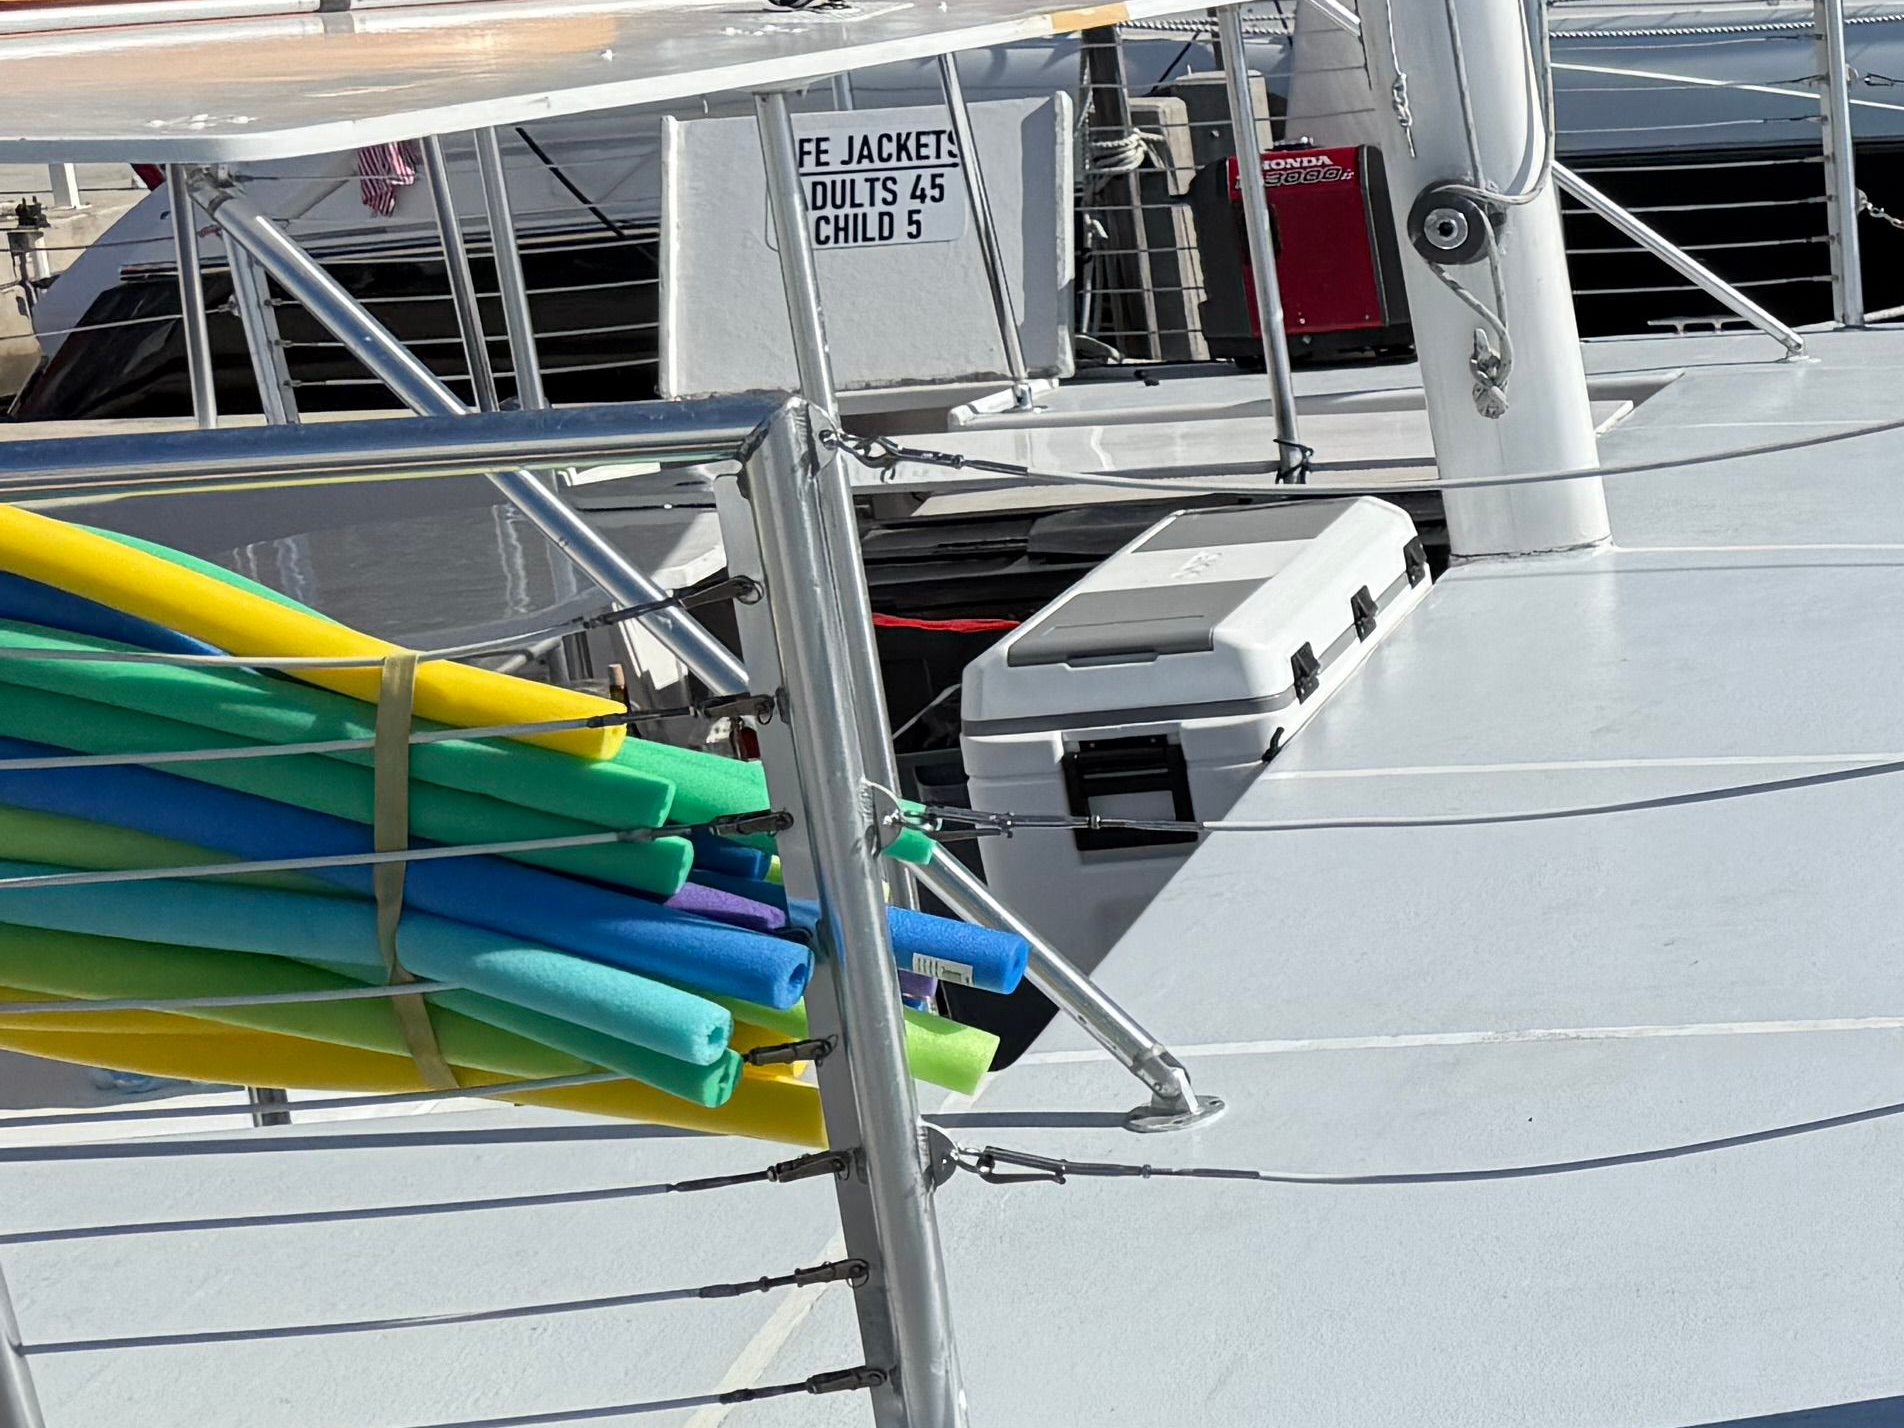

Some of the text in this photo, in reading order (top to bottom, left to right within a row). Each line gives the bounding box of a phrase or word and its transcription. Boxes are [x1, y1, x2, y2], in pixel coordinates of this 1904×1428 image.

[798, 137, 830, 168] FE
[910, 173, 945, 204] 45
[814, 209, 922, 245] CHILD 5
